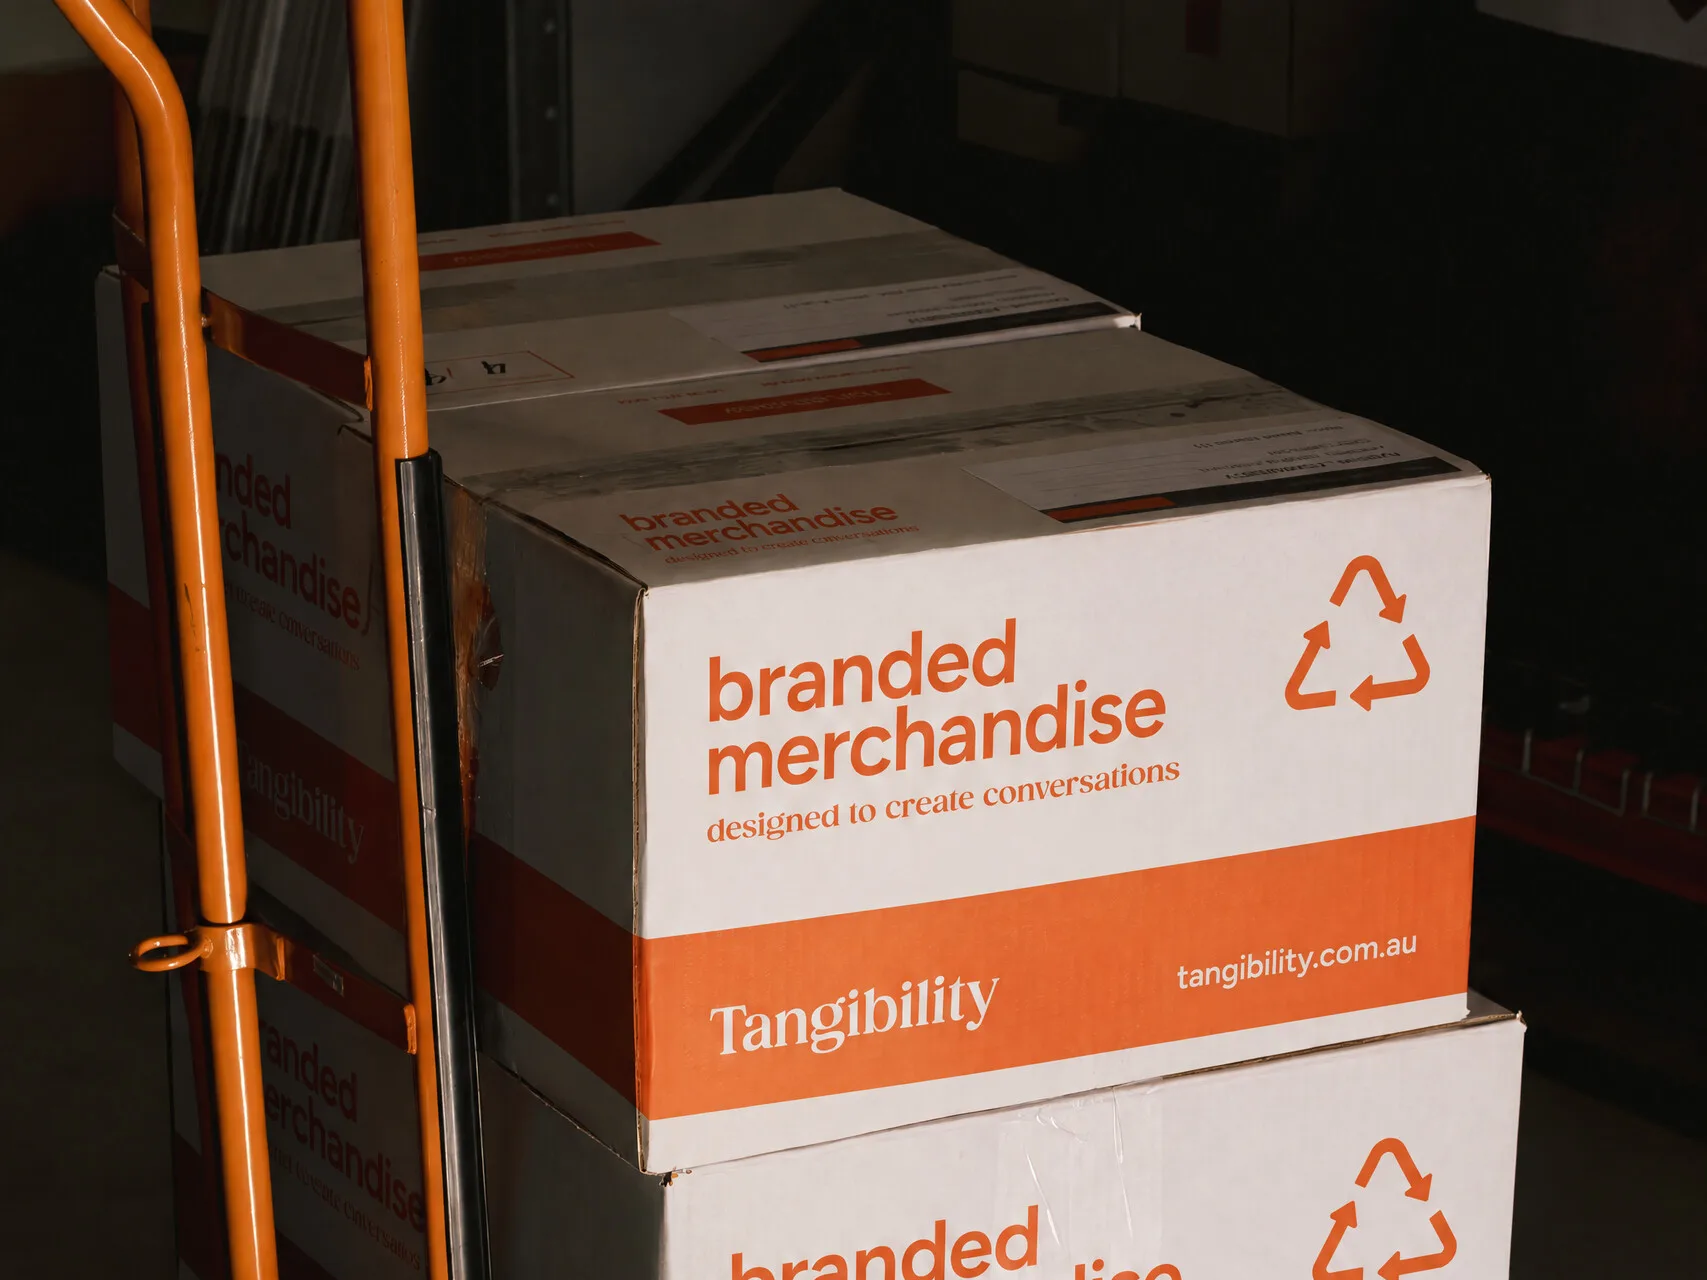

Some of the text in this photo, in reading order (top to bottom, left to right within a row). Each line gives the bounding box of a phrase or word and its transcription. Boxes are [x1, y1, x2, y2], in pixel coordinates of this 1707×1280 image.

[216, 452, 291, 529] nded
[619, 493, 800, 532] branded
[645, 506, 898, 551] merchandise
[219, 510, 361, 629] chandise
[709, 618, 1016, 722] branded
[708, 680, 1167, 795] merchandise
[707, 762, 1180, 843] designed to create conversations
[1177, 935, 1417, 991] tangibility.com.au
[709, 976, 1000, 1056] Tangibility
[258, 1019, 357, 1123] anded
[265, 1081, 425, 1234] erchandise
